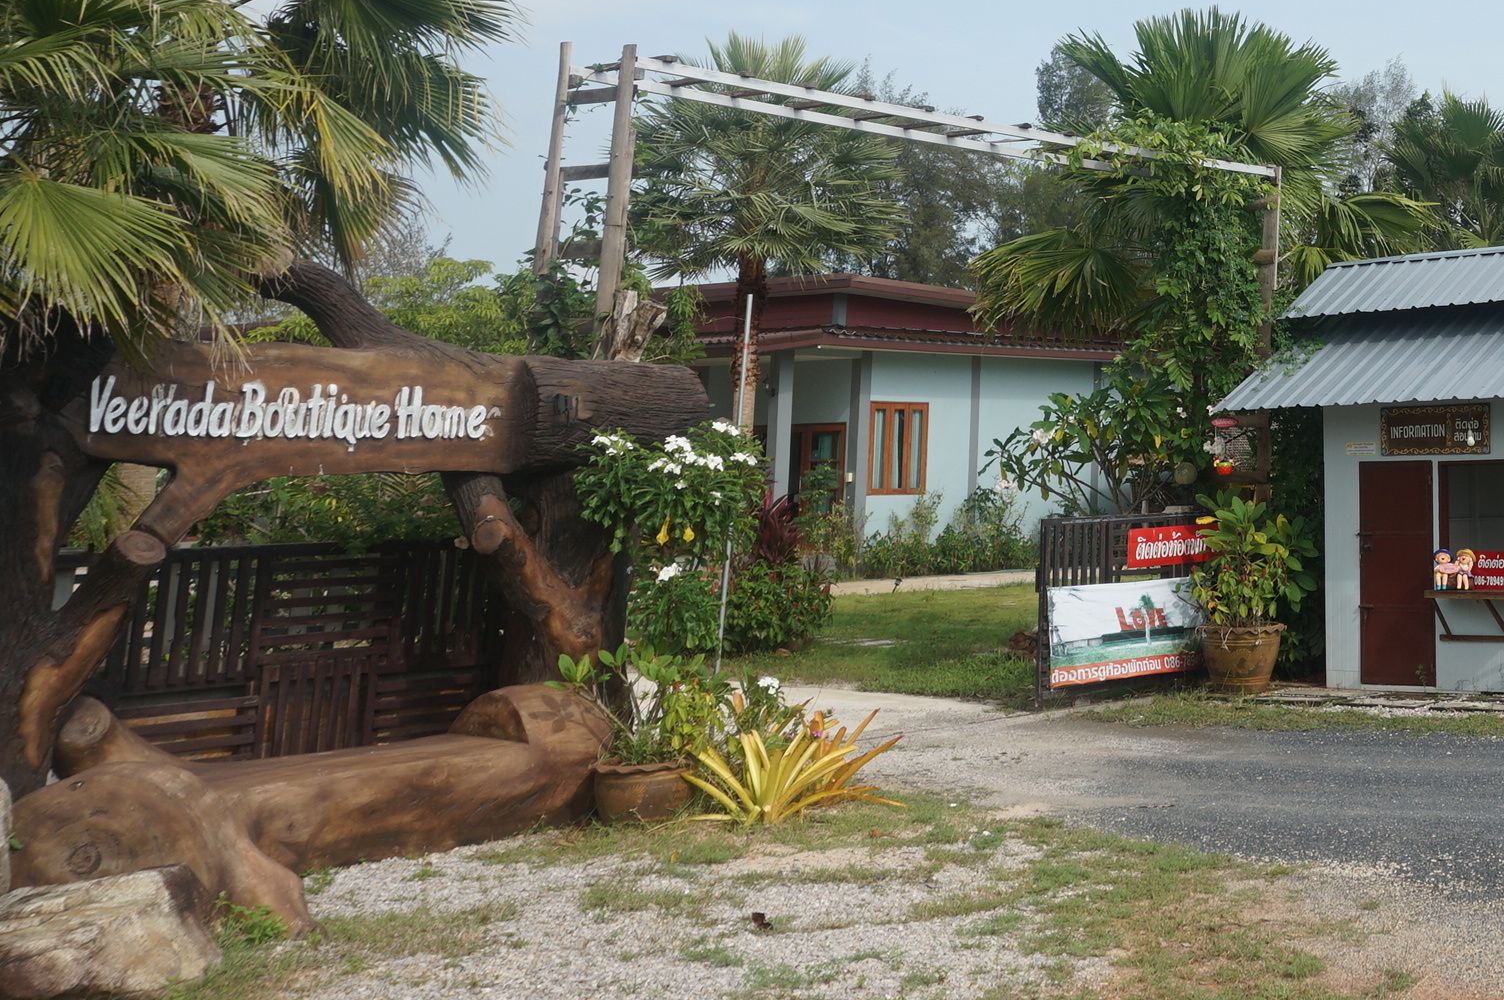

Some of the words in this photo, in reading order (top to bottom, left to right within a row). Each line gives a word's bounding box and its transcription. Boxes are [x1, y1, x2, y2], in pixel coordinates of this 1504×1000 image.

[90, 375, 235, 437] Veerada
[236, 383, 391, 444] Boutique
[397, 385, 487, 439] Home
[1455, 417, 1479, 429] ติดต่อ
[1390, 424, 1445, 439] INFORMATION
[1453, 431, 1482, 442] สอบาม
[1114, 606, 1168, 631] LOVE
